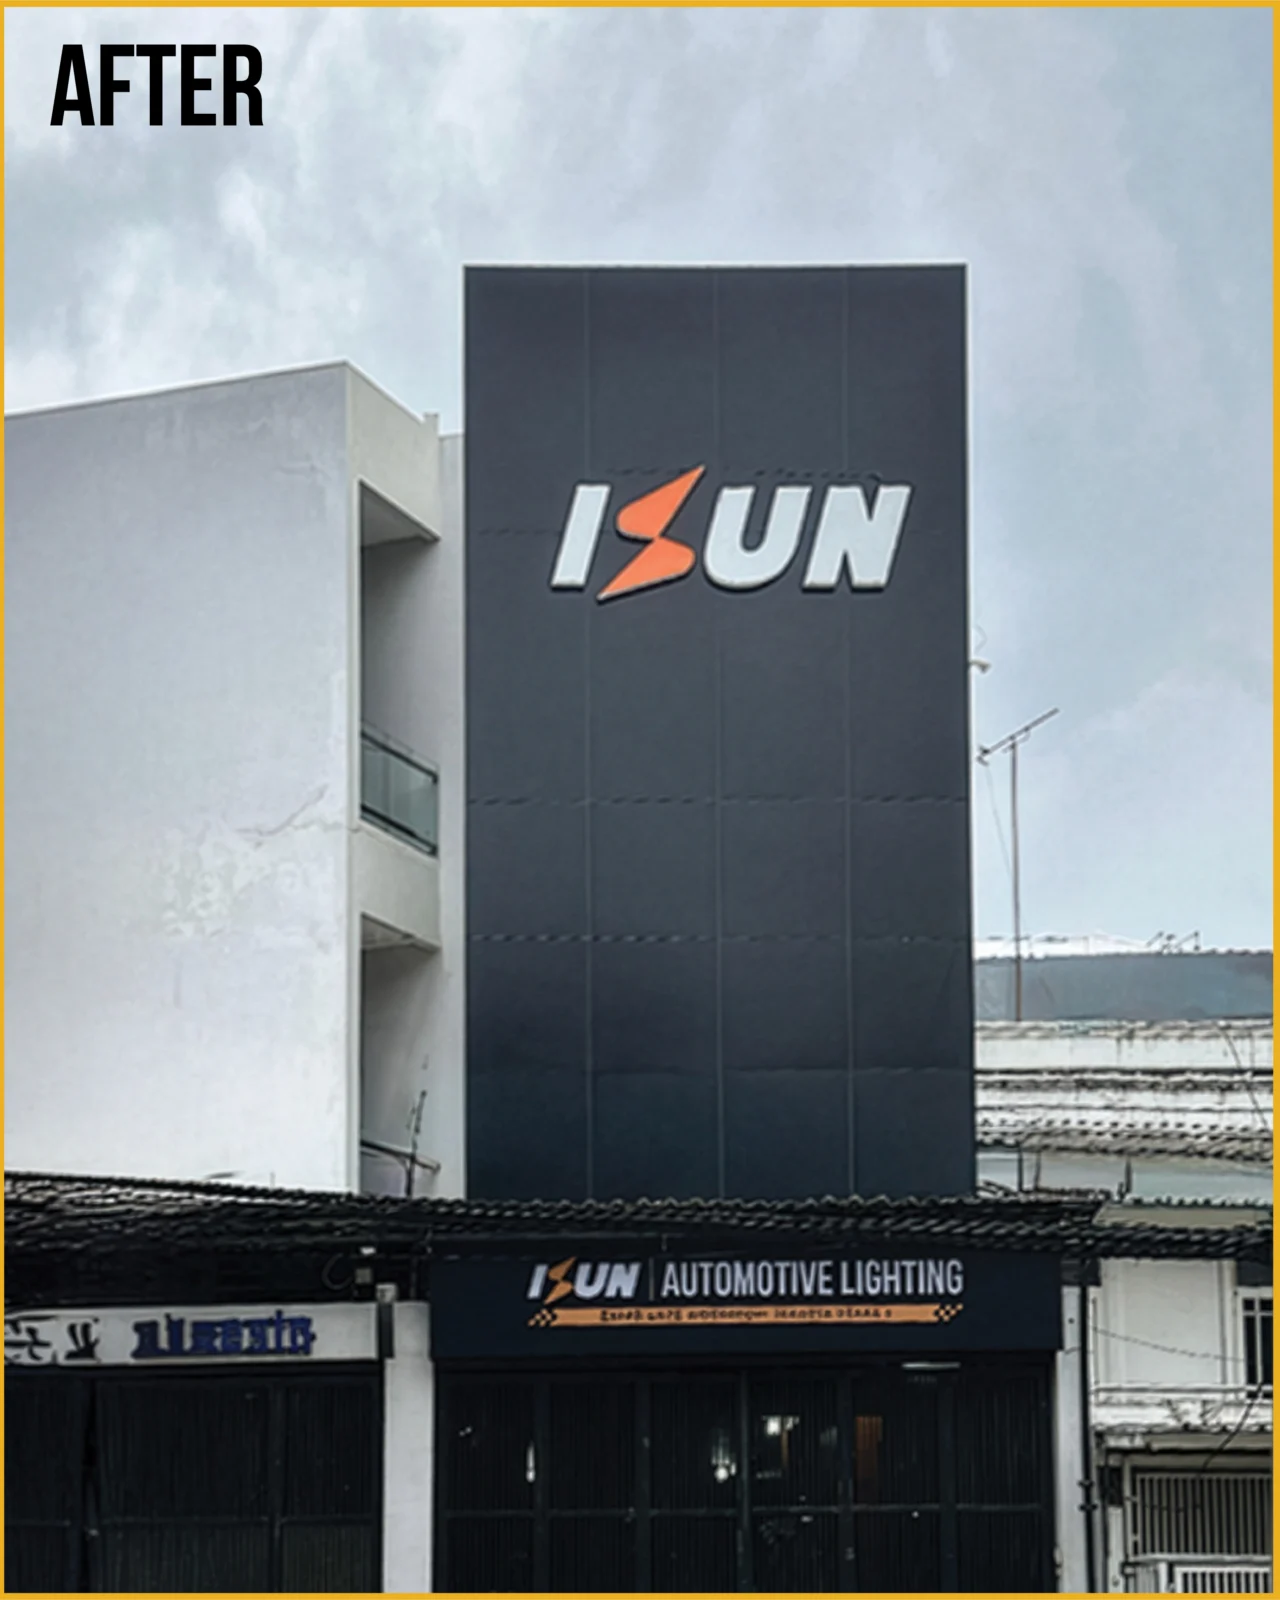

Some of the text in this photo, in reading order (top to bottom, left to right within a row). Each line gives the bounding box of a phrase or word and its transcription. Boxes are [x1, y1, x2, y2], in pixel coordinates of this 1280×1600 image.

[551, 465, 911, 602] ISUN
[527, 1256, 963, 1305] ISUN AUTOMOTIVE LIGHTING
